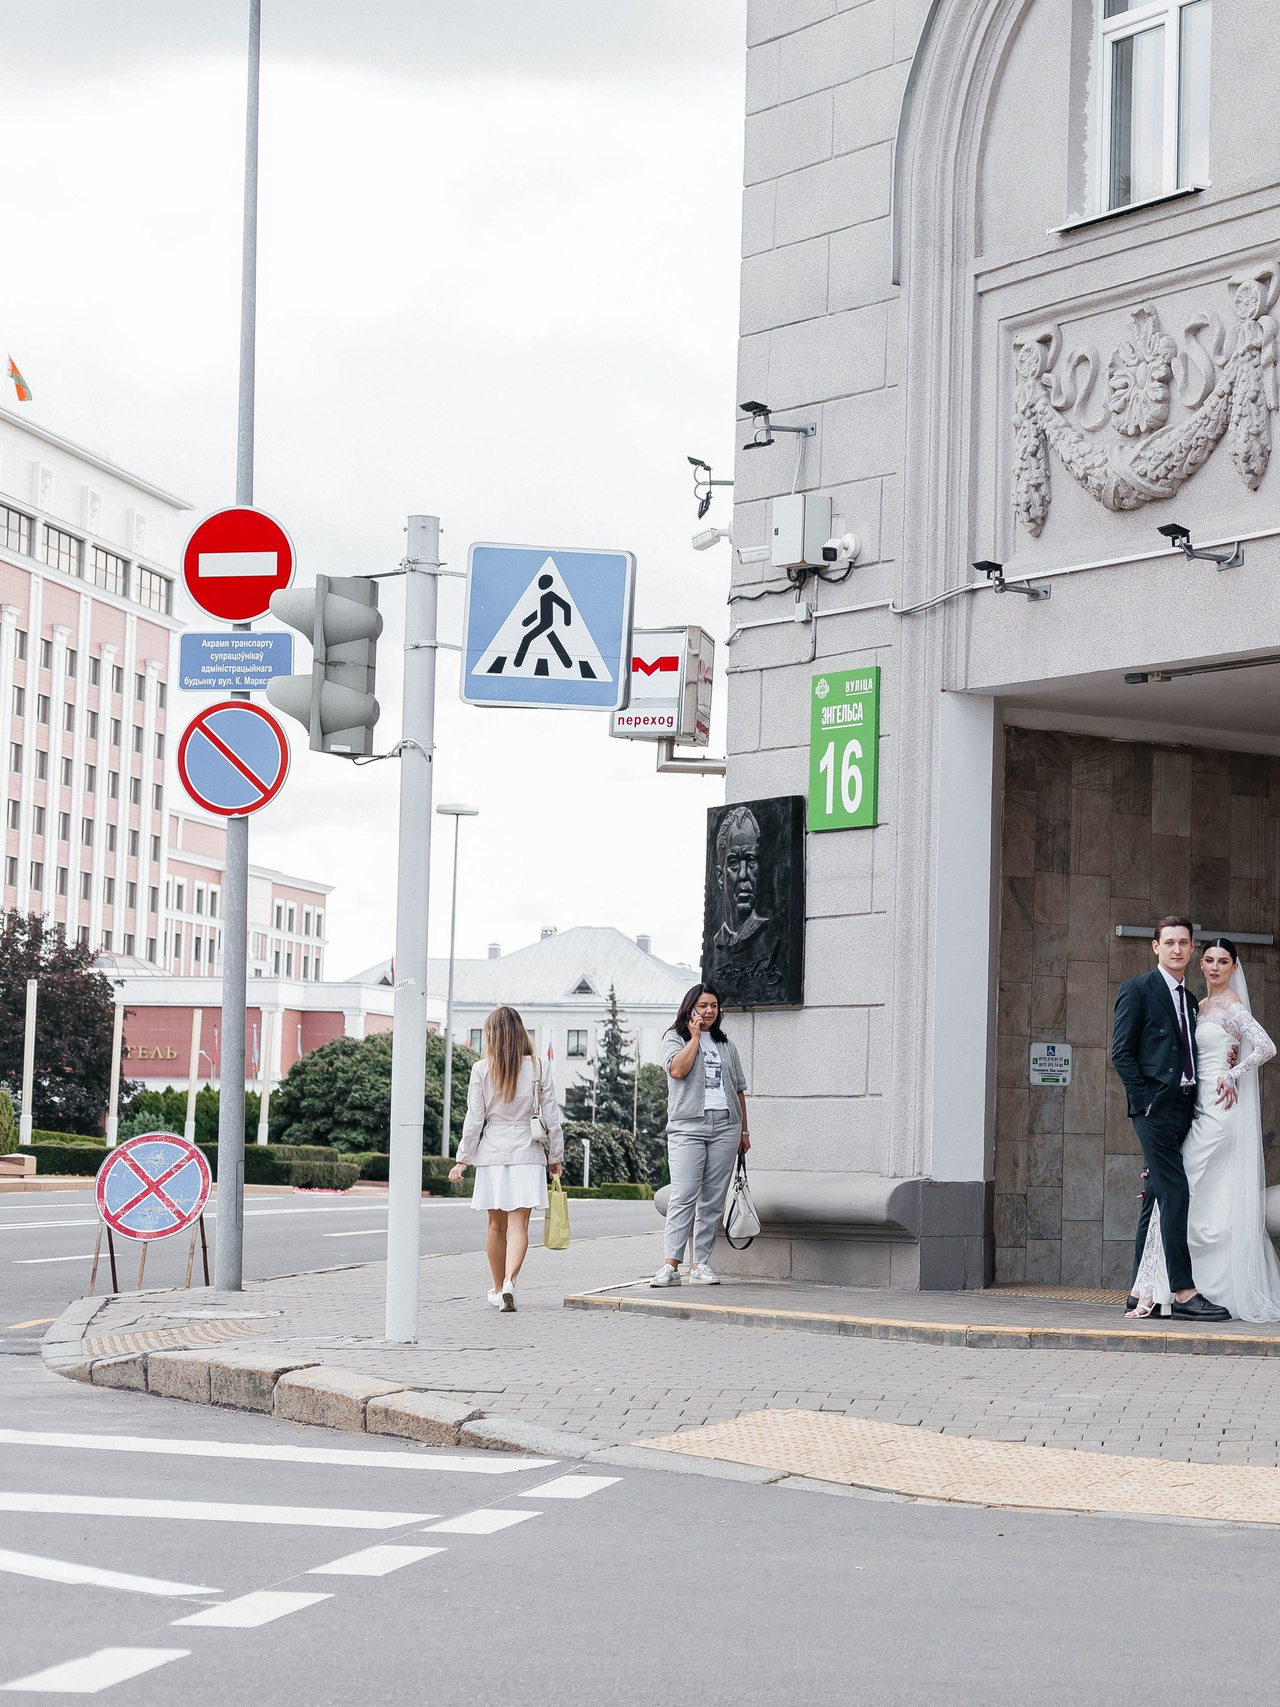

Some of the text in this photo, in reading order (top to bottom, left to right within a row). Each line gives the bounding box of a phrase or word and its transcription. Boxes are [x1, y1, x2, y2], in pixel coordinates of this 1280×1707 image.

[201, 639, 274, 650] Акрамя транспарту
[210, 651, 264, 662] супрацоўнікаў
[201, 664, 272, 674] адміністрацыйнага
[184, 676, 216, 686] будынку
[236, 677, 242, 685] К.
[244, 677, 269, 686] Маркс
[845, 678, 873, 693] ВУЛІЦА
[821, 702, 863, 726] ЭНГЕЛЬСА
[618, 716, 674, 728] переход
[819, 738, 863, 815] 16
